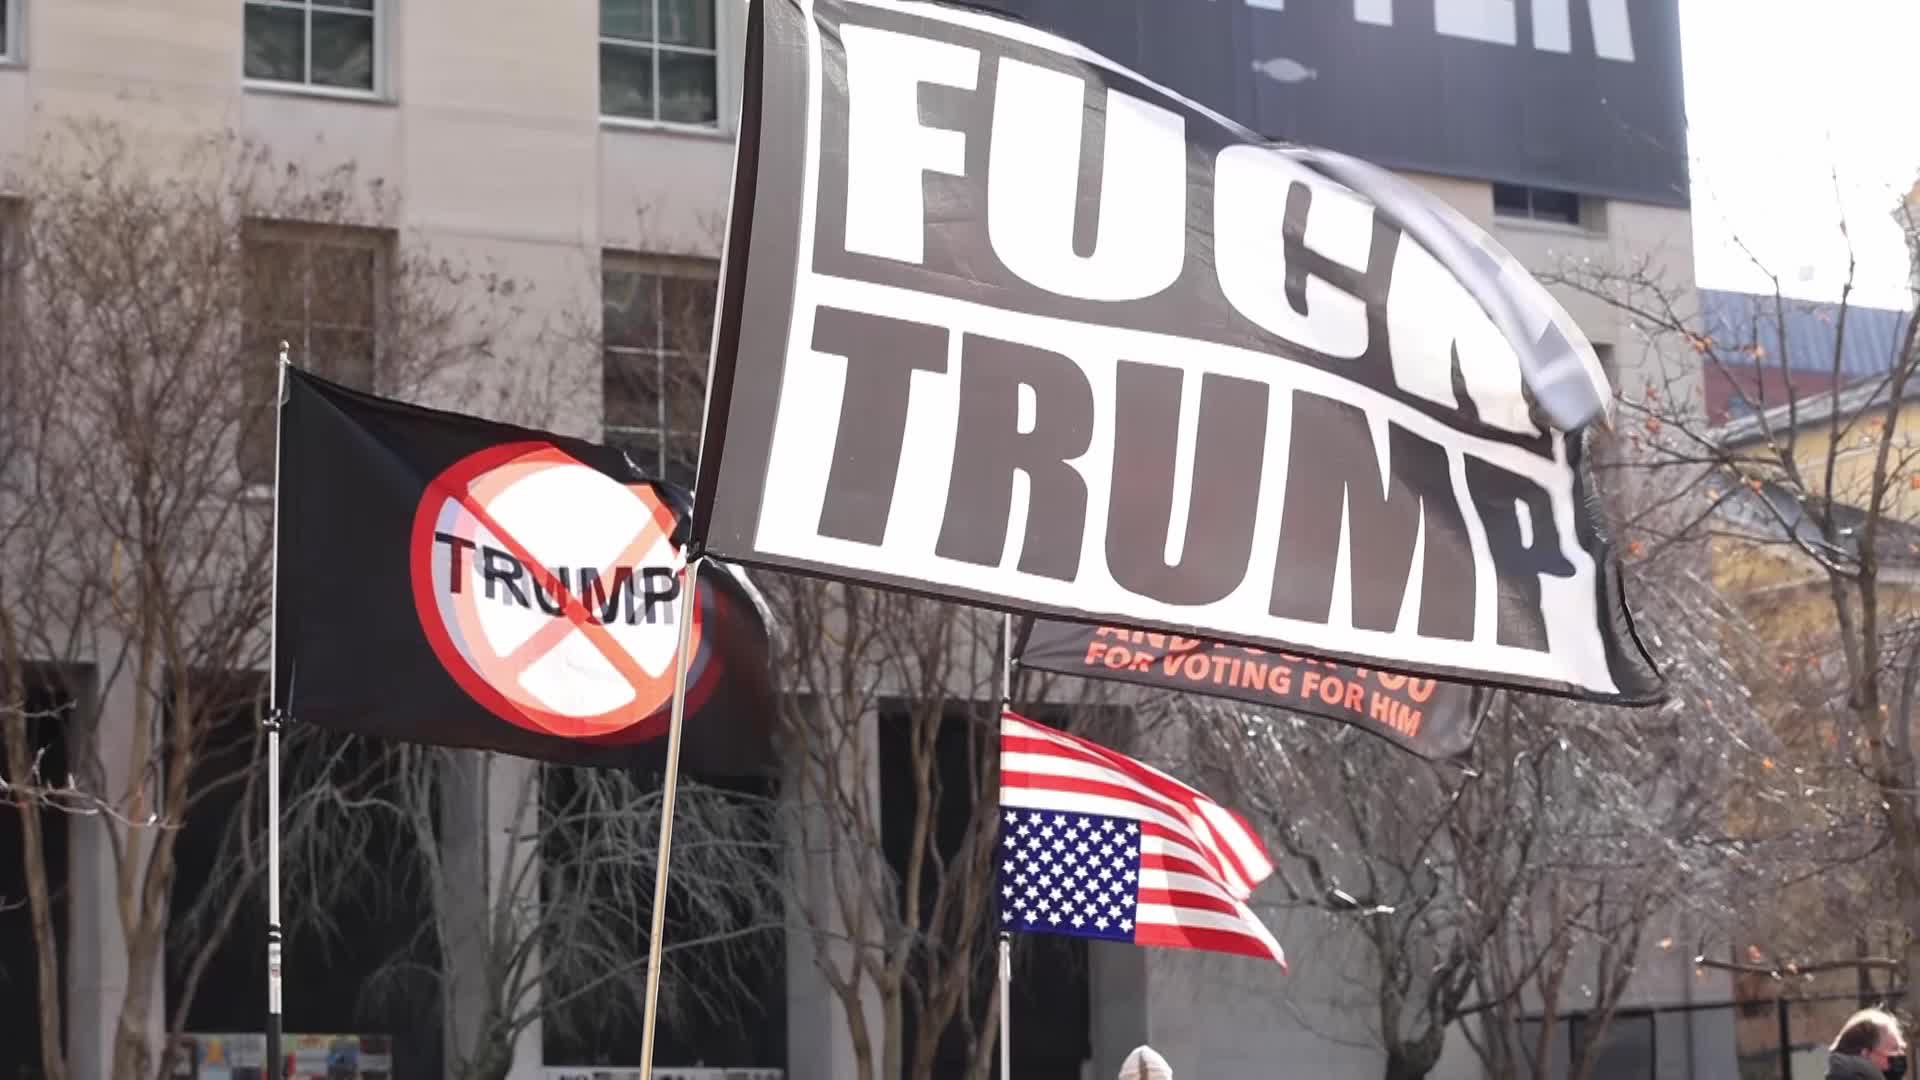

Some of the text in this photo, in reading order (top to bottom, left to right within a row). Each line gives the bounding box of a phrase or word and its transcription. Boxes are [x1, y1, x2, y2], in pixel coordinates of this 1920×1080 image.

[811, 305, 1576, 654] TRUMP
[434, 530, 681, 626] TRUMP
[1084, 641, 1153, 673] FOR
[1162, 653, 1293, 695] VOTING
[1301, 671, 1365, 713] FOR
[1369, 690, 1423, 737] HIM
